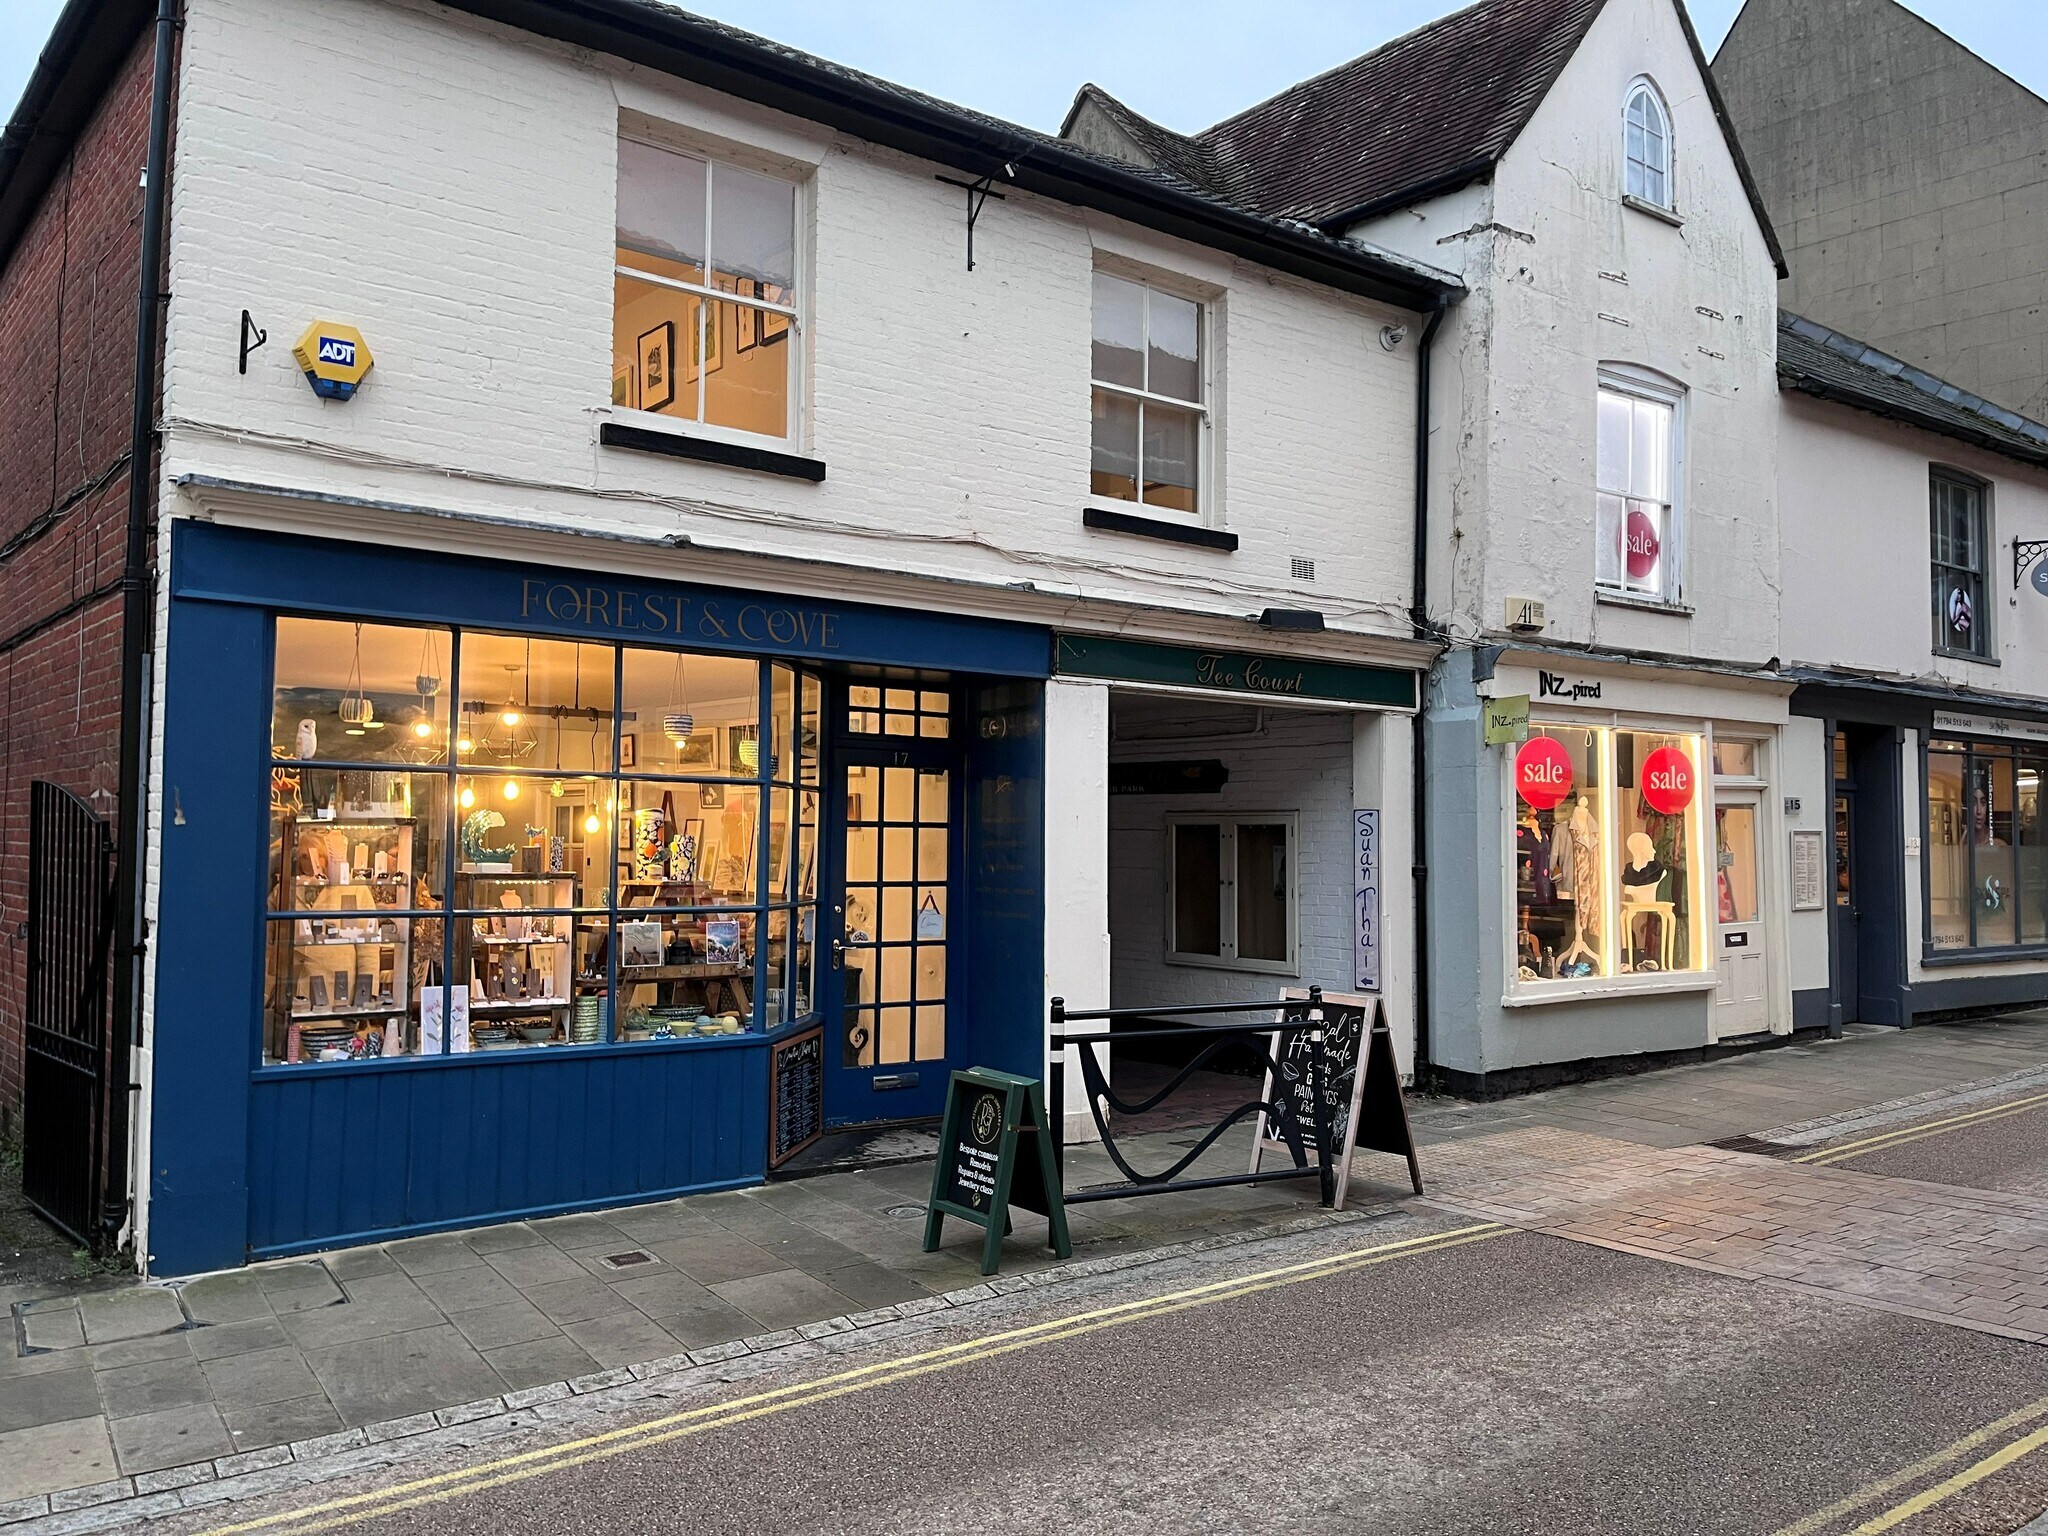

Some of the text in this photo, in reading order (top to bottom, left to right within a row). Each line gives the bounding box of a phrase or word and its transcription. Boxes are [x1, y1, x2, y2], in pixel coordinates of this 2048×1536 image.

[319, 342, 355, 362] ADT
[1627, 531, 1652, 555] sale
[521, 579, 840, 648] FOREST & COVE
[1516, 602, 1532, 624] A1
[1196, 654, 1304, 692] Tee Court
[1936, 716, 1952, 726] 01794
[1952, 718, 1962, 727] 513
[894, 751, 908, 765] 17
[1524, 756, 1563, 784] sale
[1650, 765, 1687, 790] sale
[1790, 799, 1801, 810] 15
[1357, 811, 1374, 881] Suan
[1356, 886, 1376, 968] Thai
[1933, 936, 1944, 944] 1794
[970, 1157, 991, 1171] Remodels
[958, 1177, 980, 1192] Jewellery
